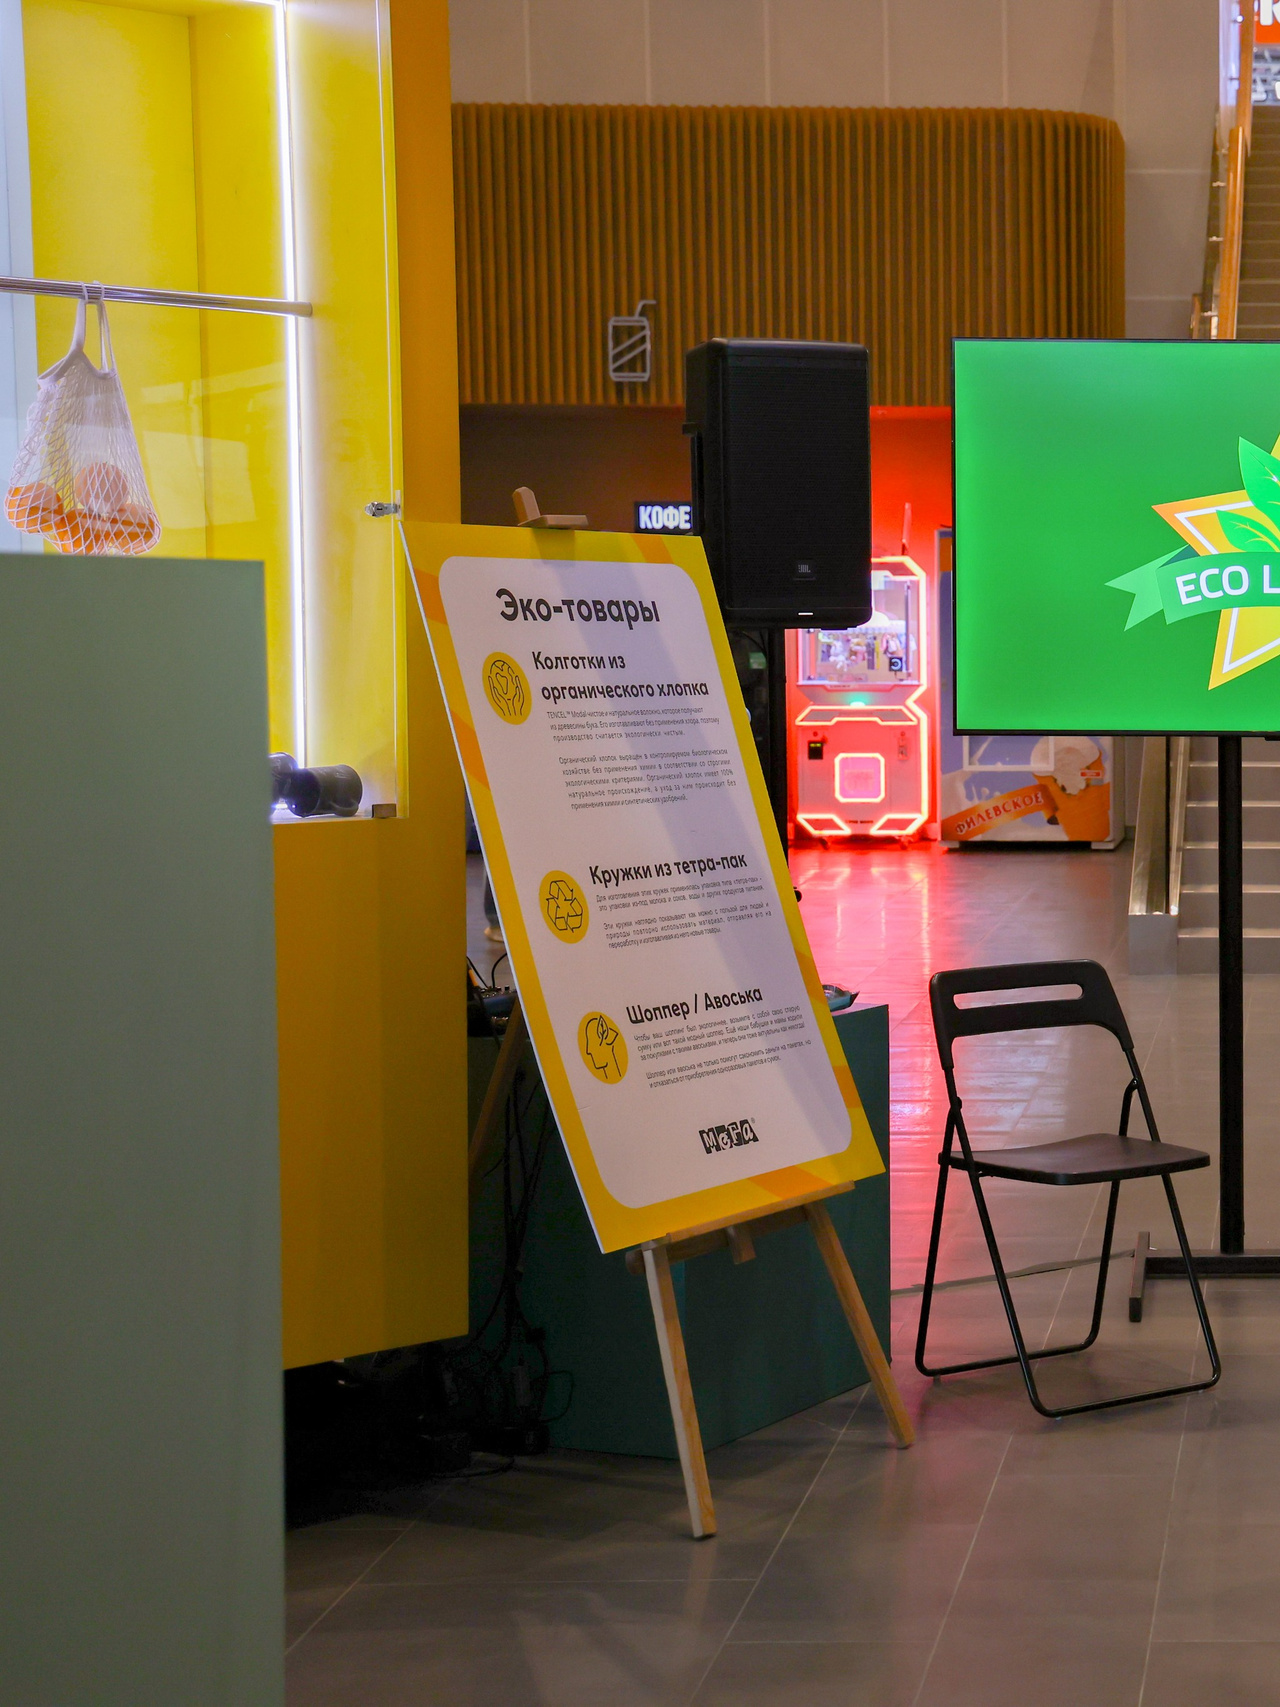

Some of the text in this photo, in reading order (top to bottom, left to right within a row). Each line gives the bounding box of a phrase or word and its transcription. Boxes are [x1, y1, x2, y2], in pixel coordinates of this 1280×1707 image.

[638, 505, 692, 530] КОФЕ
[798, 564, 811, 573] JBL
[1175, 564, 1250, 605] ECO
[496, 588, 660, 630] Эко-товары
[532, 651, 626, 670] Колготки из
[542, 683, 709, 705] органического хлопка
[954, 790, 1045, 835] ФИЛЕВСКОЕ
[589, 855, 747, 888] Кружки из тетра-пак
[626, 1002, 690, 1024] Шоппер
[705, 989, 763, 1011] Авоська
